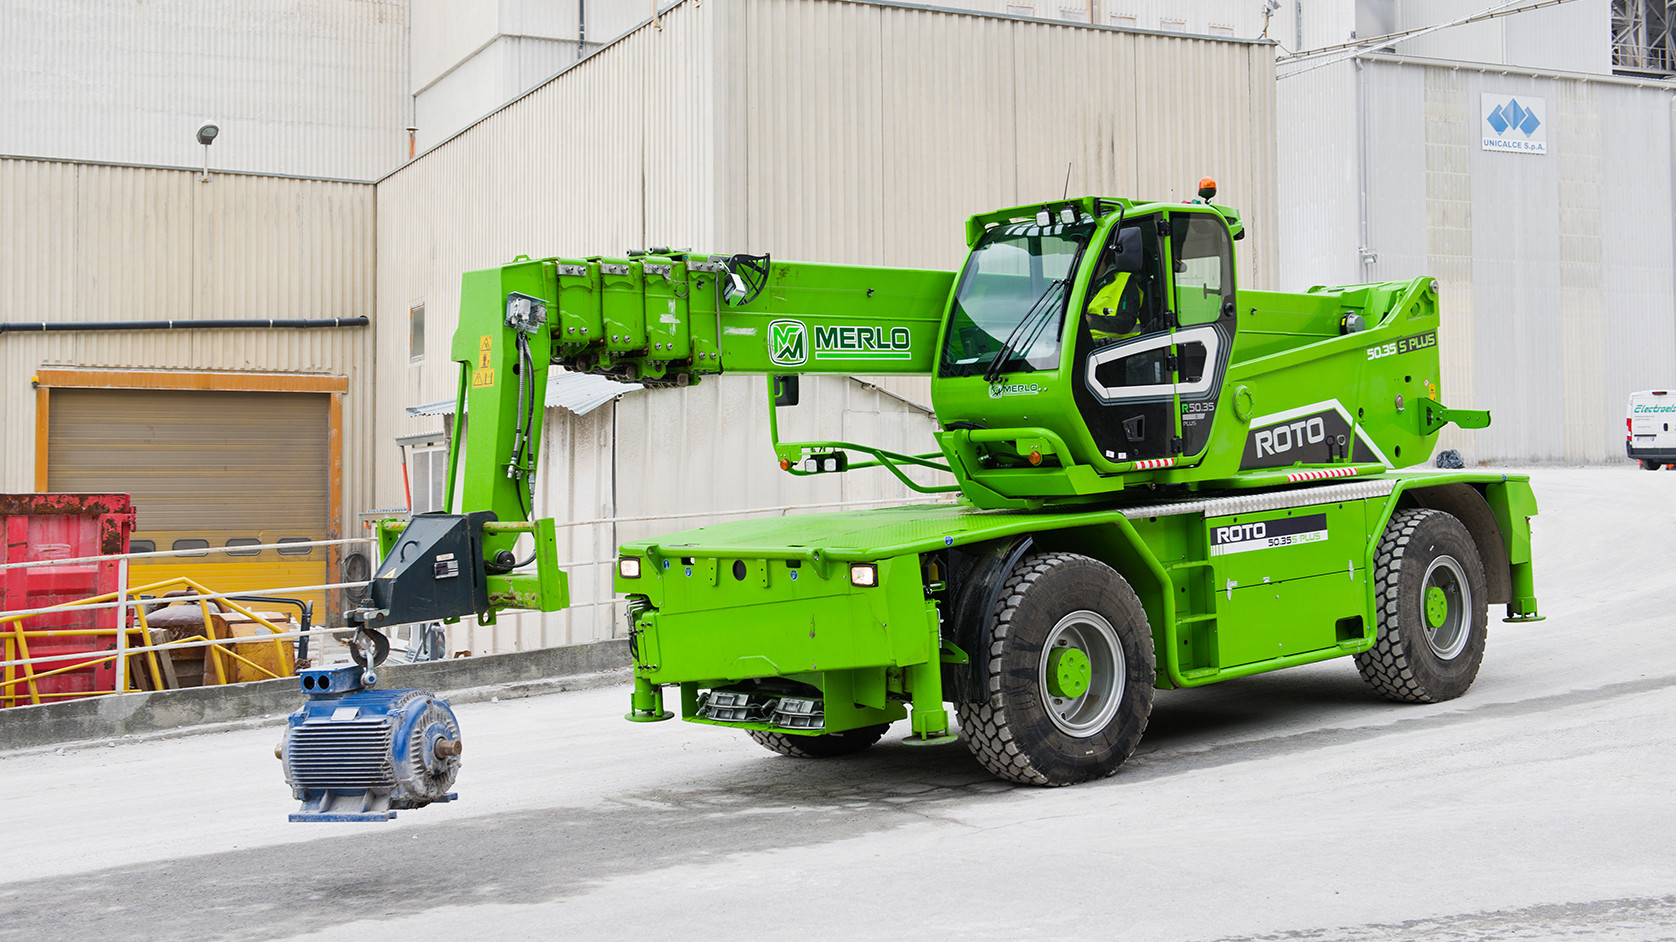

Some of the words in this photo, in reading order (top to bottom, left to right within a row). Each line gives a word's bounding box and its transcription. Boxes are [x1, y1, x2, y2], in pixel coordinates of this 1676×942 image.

[1484, 139, 1521, 148] UNICALCE
[1524, 142, 1544, 150] S.p.A.
[814, 325, 911, 350] MERLO
[1367, 343, 1396, 360] 50.35
[1399, 341, 1406, 353] S
[1409, 334, 1435, 350] PLUS
[1002, 383, 1038, 393] MERLO
[1181, 402, 1214, 413] R50.35
[1634, 404, 1676, 413] Electroel
[1255, 417, 1324, 458] ROTO
[1217, 522, 1266, 543] ROTO
[1299, 532, 1321, 542] PLUS
